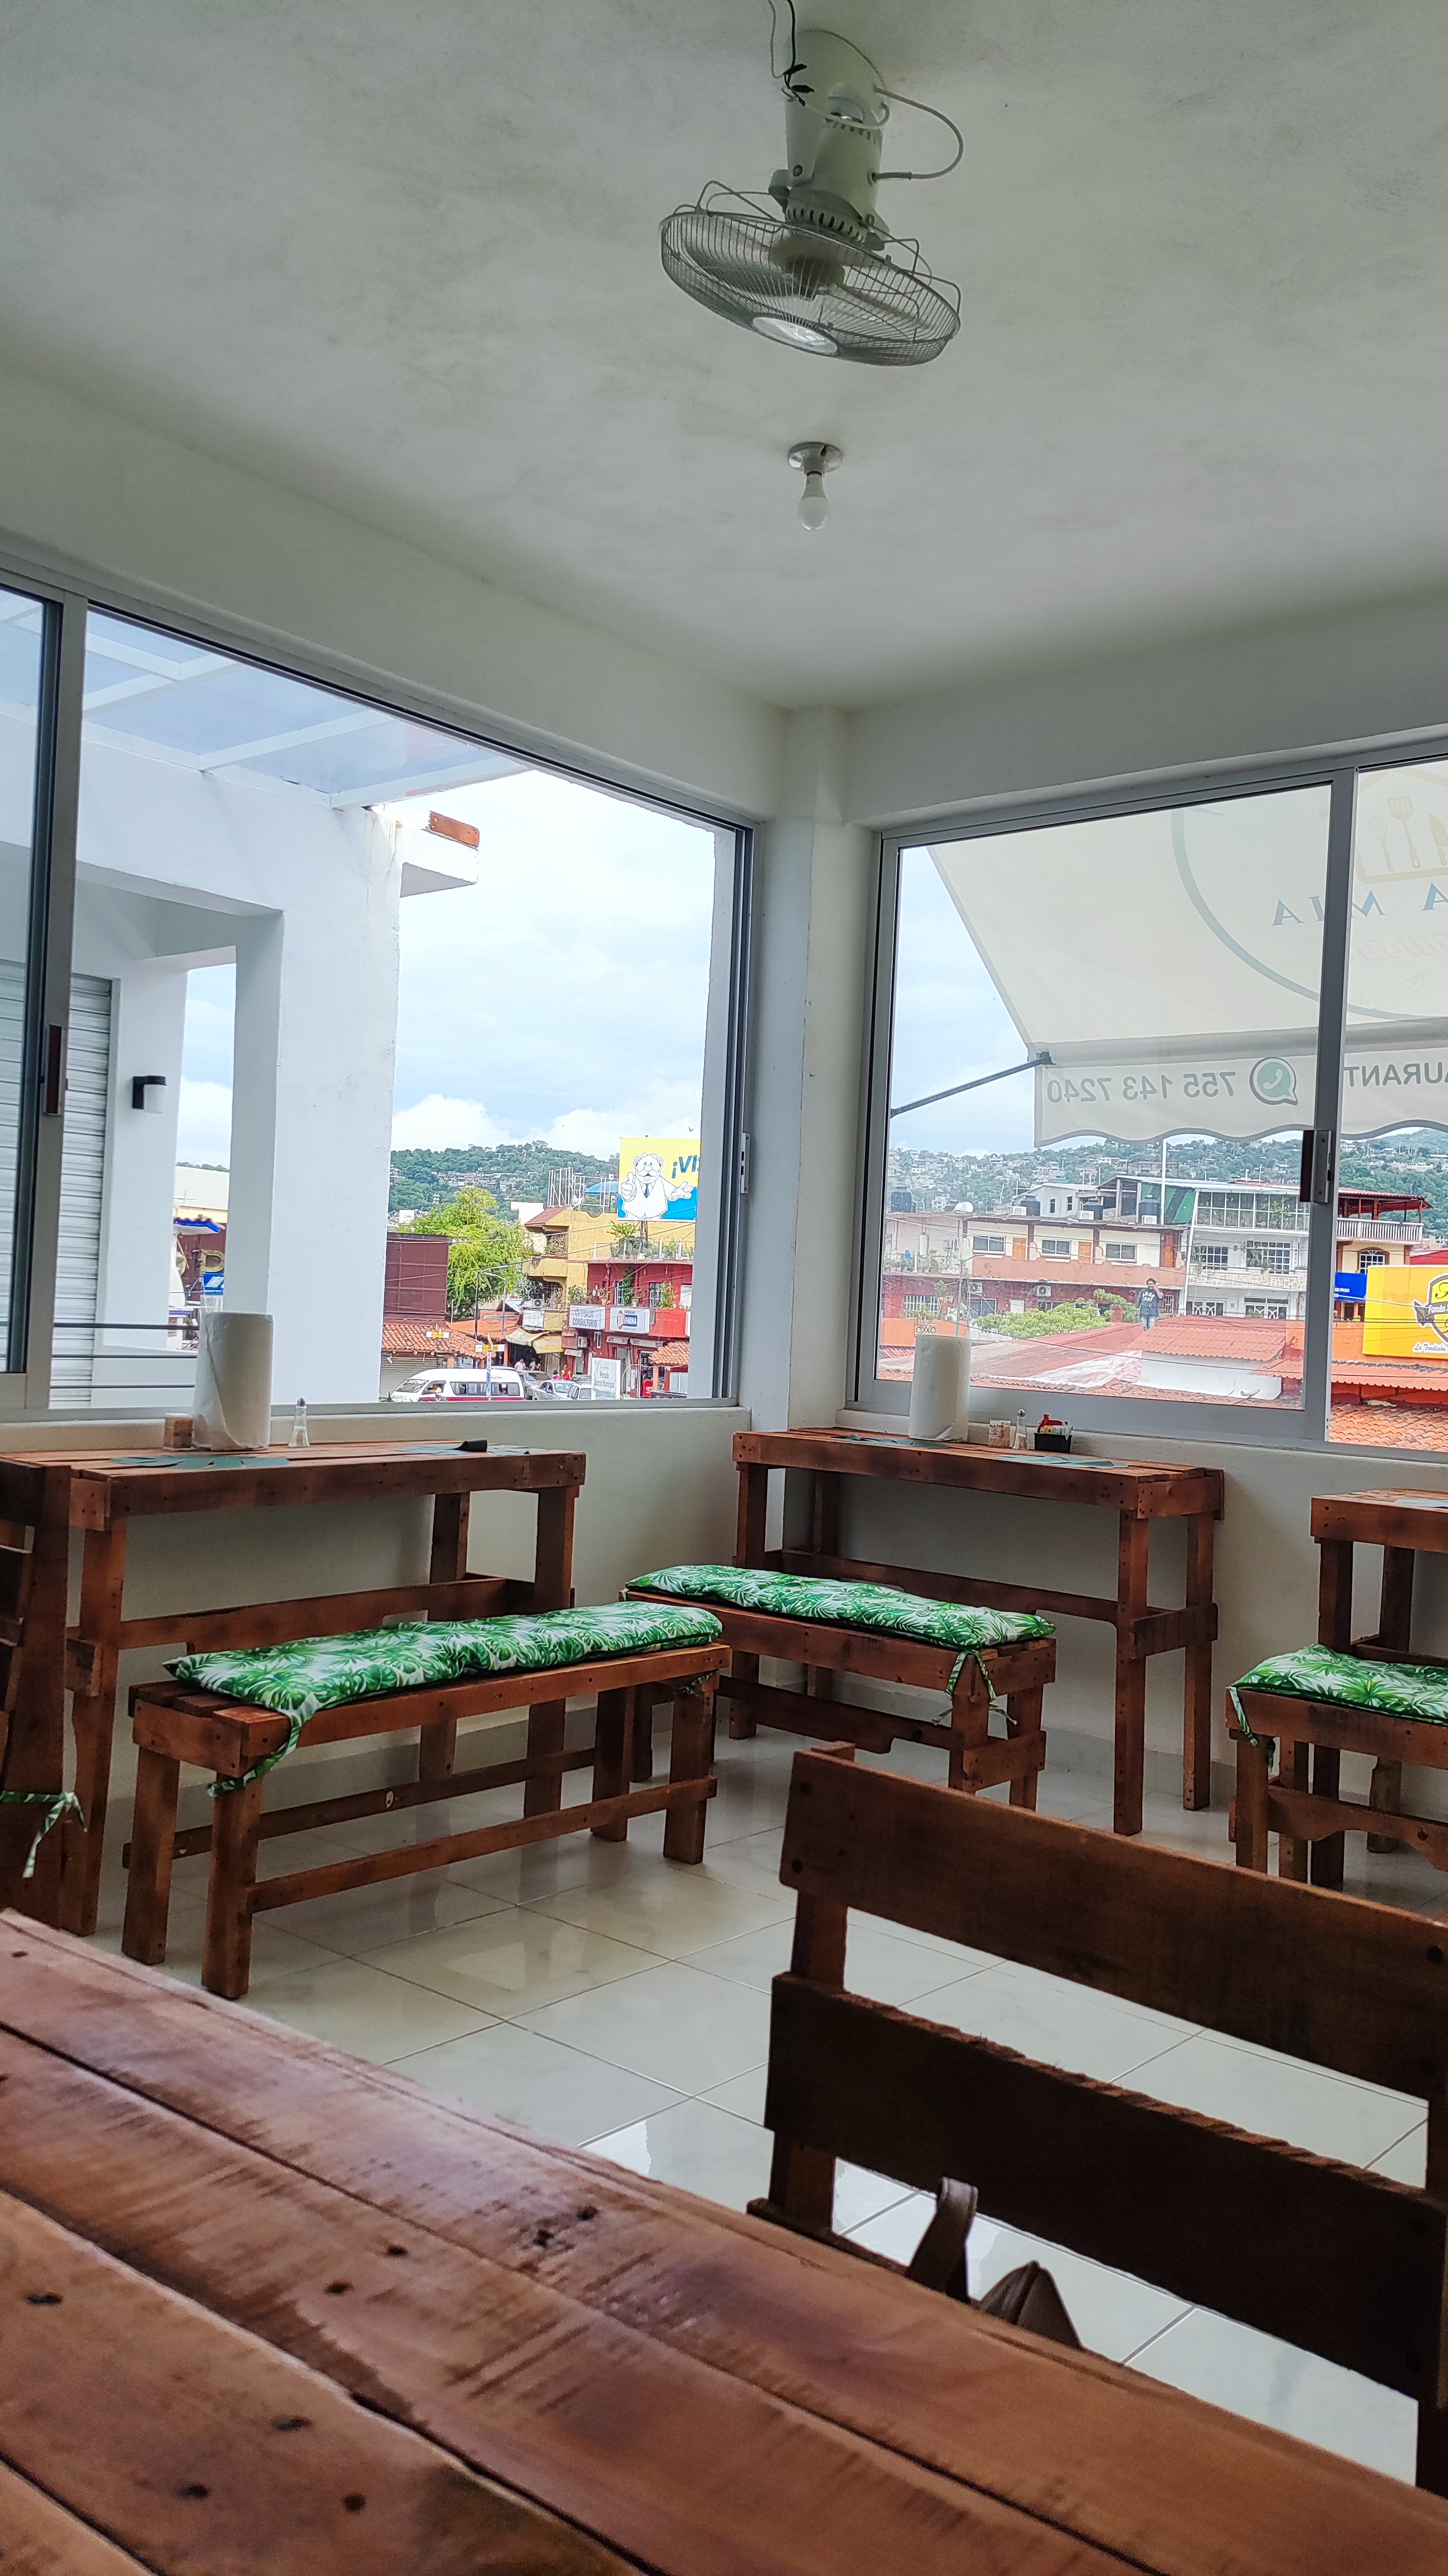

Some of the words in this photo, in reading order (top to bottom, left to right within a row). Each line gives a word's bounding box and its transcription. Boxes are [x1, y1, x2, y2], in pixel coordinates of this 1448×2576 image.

[671, 1154, 700, 1179] ¡VI
[573, 1318, 597, 1328] CONSULTORIO
[916, 1325, 937, 1334] OXXO
